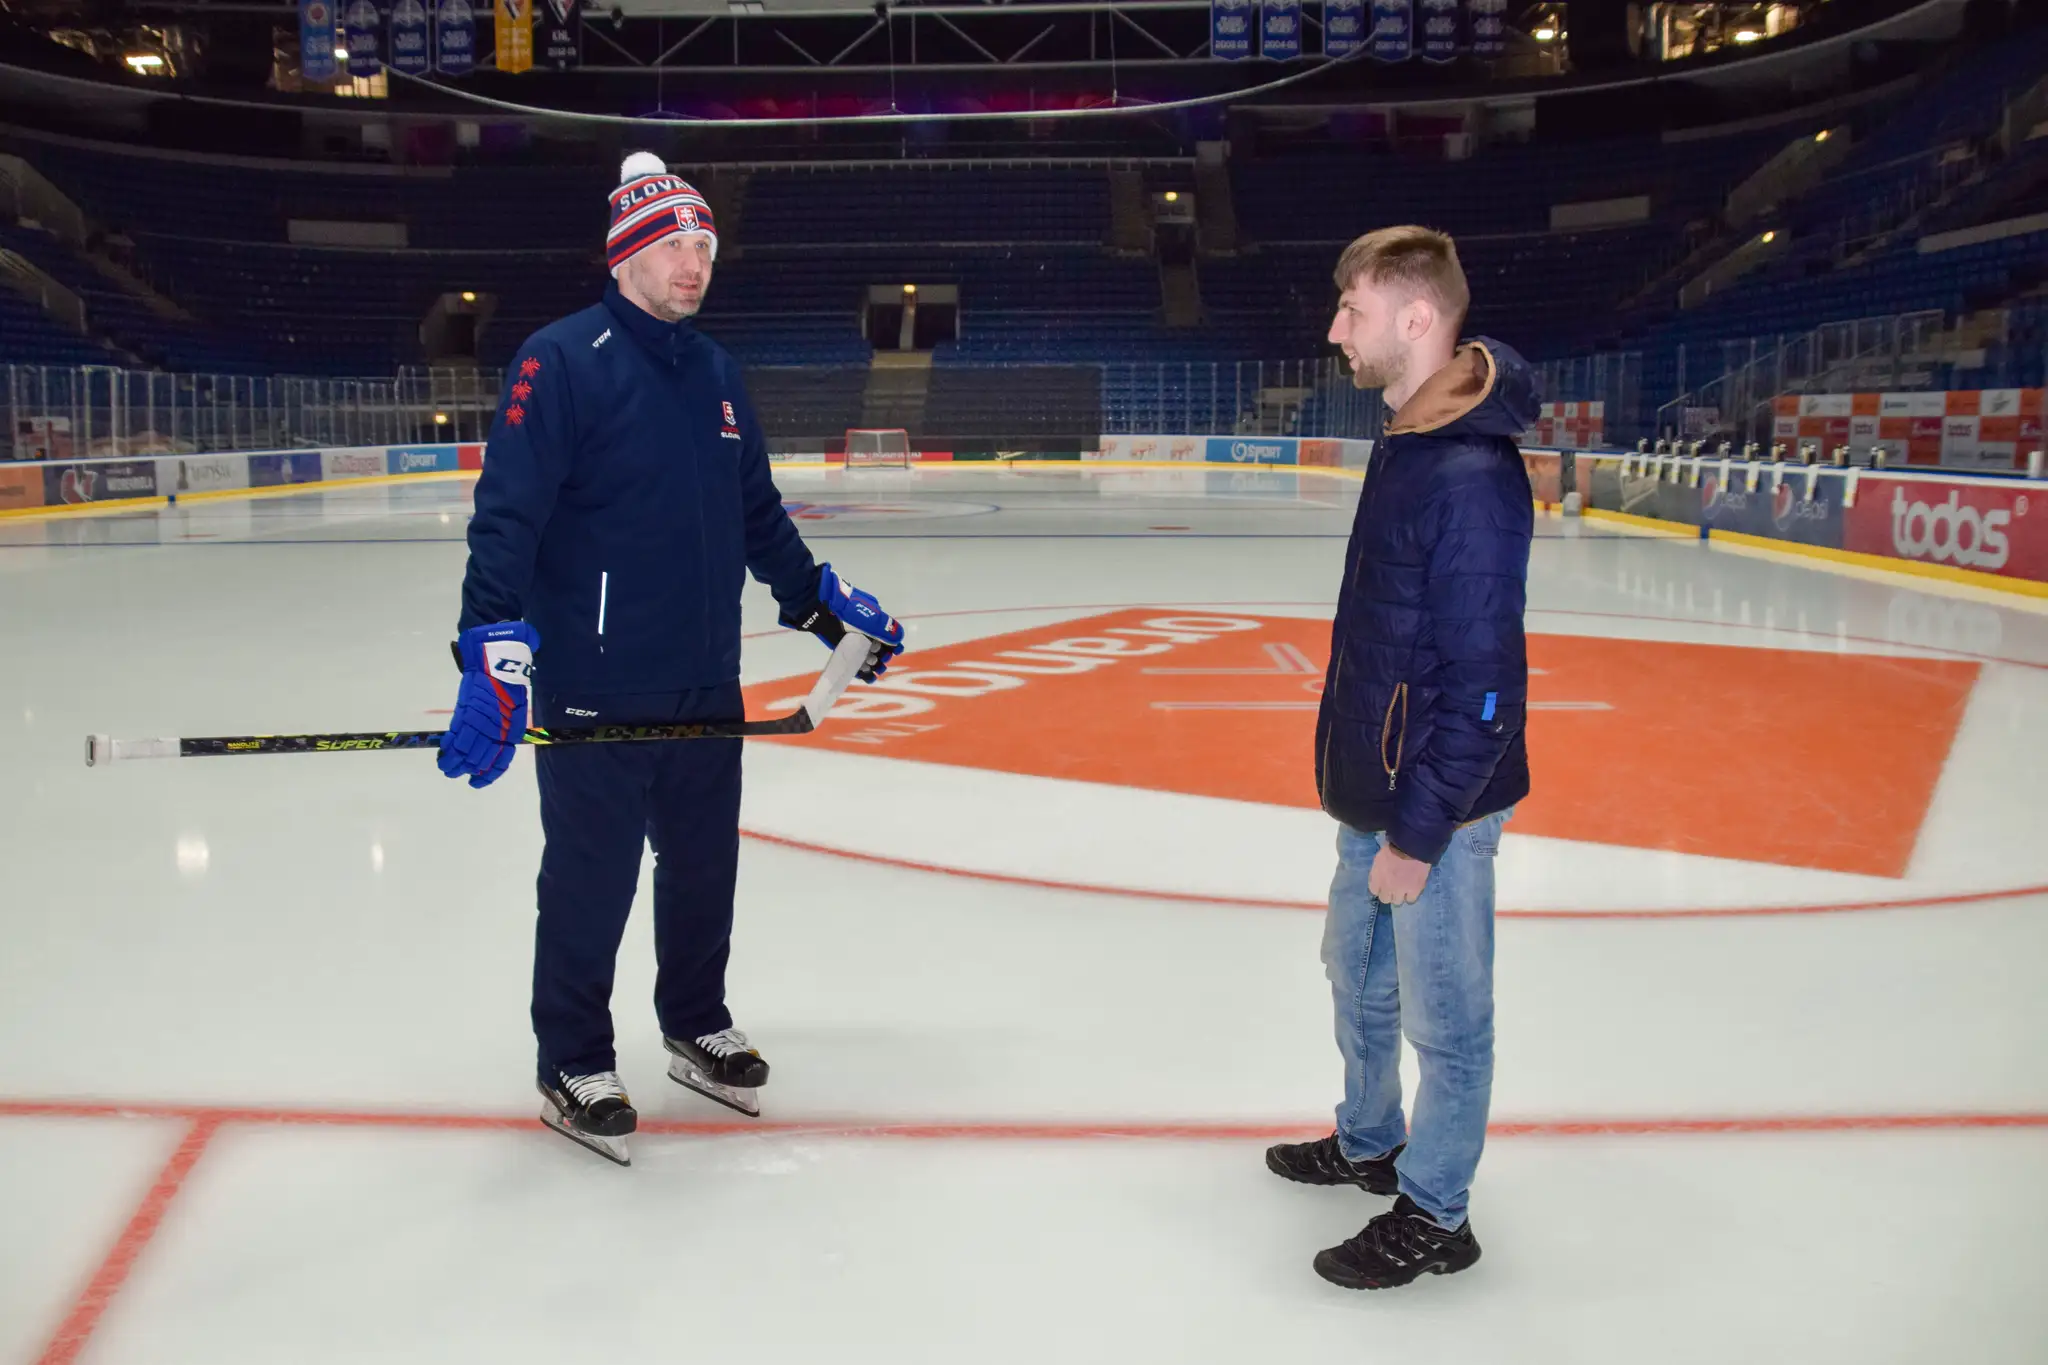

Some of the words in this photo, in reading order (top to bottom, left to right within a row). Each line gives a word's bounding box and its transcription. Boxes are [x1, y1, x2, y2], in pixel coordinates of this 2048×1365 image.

[1891, 485, 2011, 569] todos
[801, 612, 820, 630] CCM
[565, 707, 598, 717] CCM
[316, 738, 384, 751] SUPER
